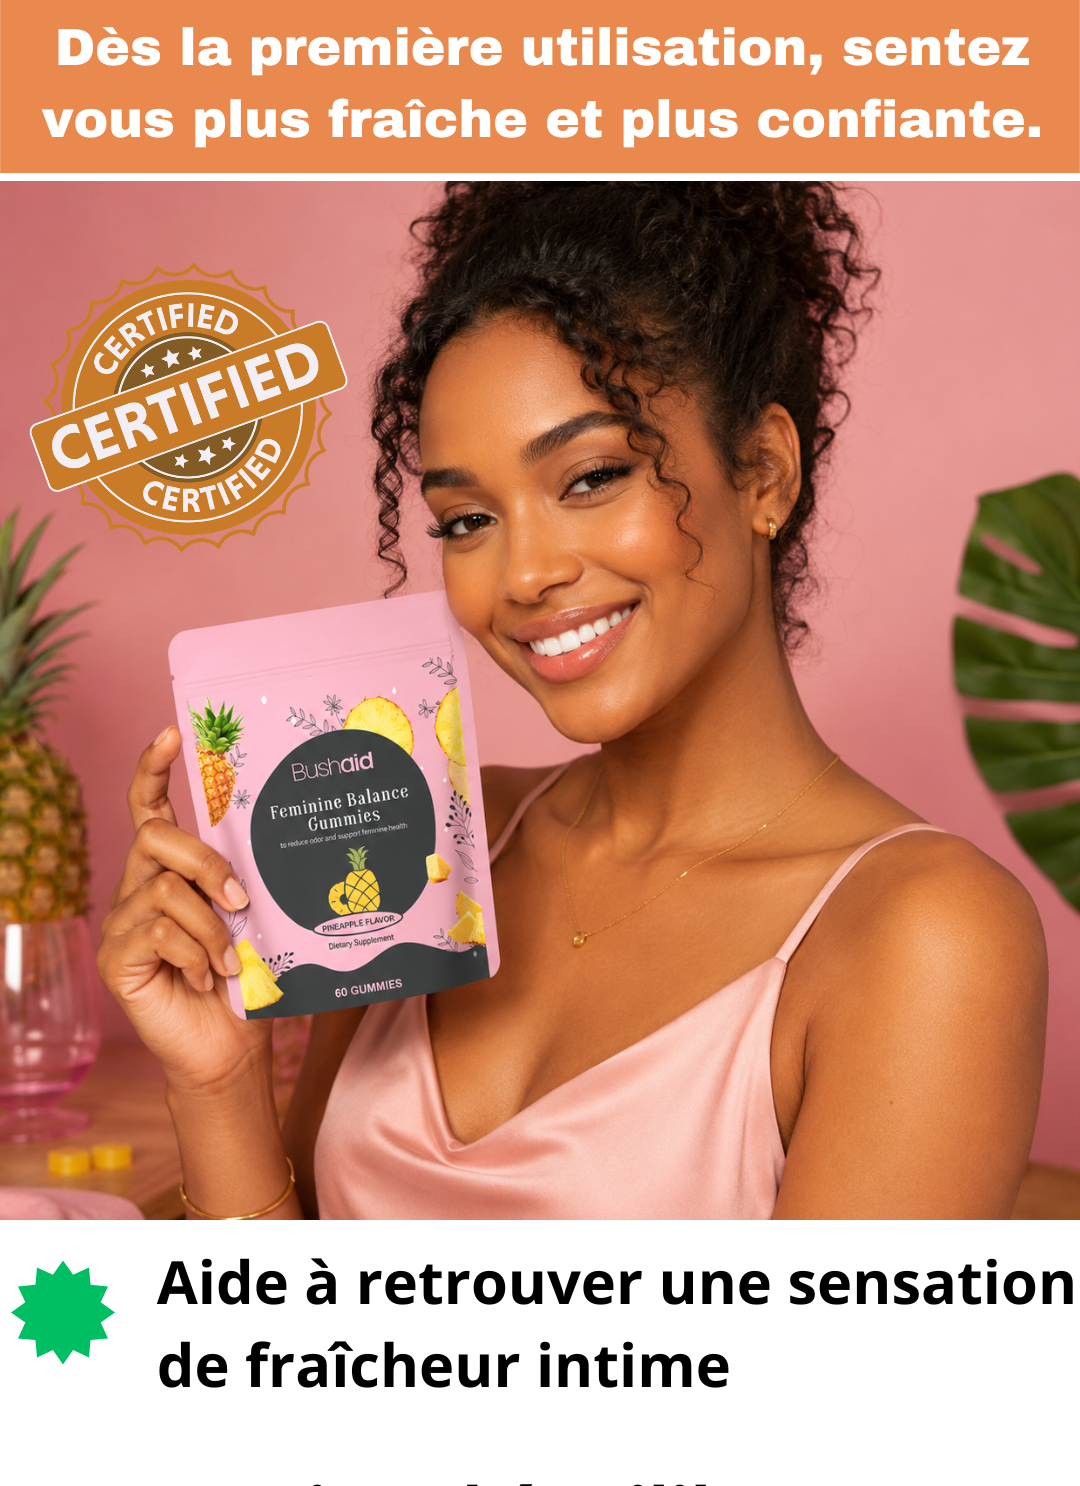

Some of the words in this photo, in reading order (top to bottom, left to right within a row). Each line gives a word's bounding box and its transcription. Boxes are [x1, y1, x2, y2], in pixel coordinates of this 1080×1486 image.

[291, 751, 375, 782] Bushaid
[270, 794, 342, 820] Feminine
[346, 786, 409, 807] Balance
[308, 809, 381, 832] Gummies
[288, 839, 309, 848] reduce
[325, 834, 337, 842] and
[362, 826, 388, 835] feminine
[388, 822, 408, 831] health
[322, 919, 364, 933] PINEAPPLE
[365, 915, 395, 926] FLAVOR
[328, 940, 353, 951] Dietary
[354, 934, 395, 947] Supplement
[335, 987, 348, 998] 60
[350, 978, 403, 995] GUMMIES
